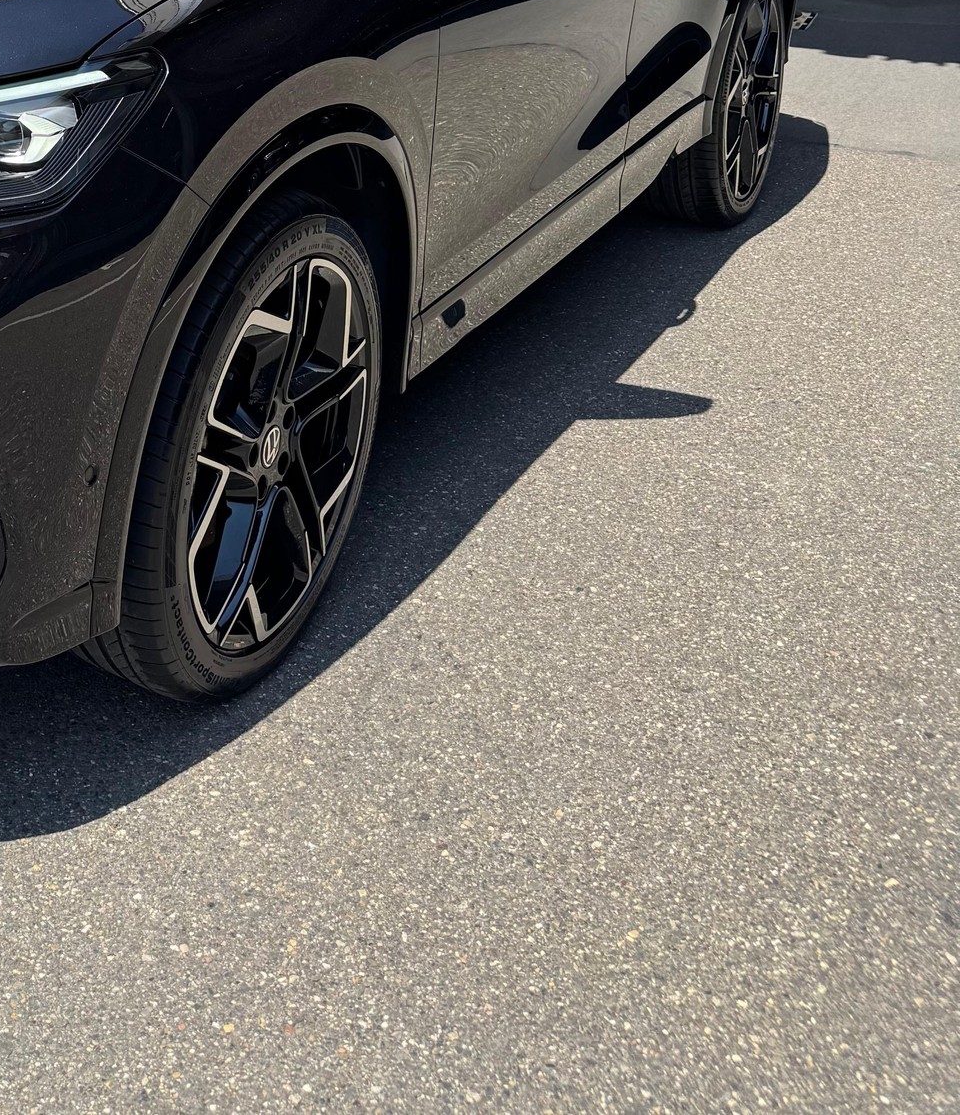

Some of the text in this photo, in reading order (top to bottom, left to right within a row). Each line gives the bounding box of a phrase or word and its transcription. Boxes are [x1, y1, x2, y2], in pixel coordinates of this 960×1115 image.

[290, 231, 303, 245] 20
[304, 226, 310, 237] V
[312, 223, 323, 235] XL
